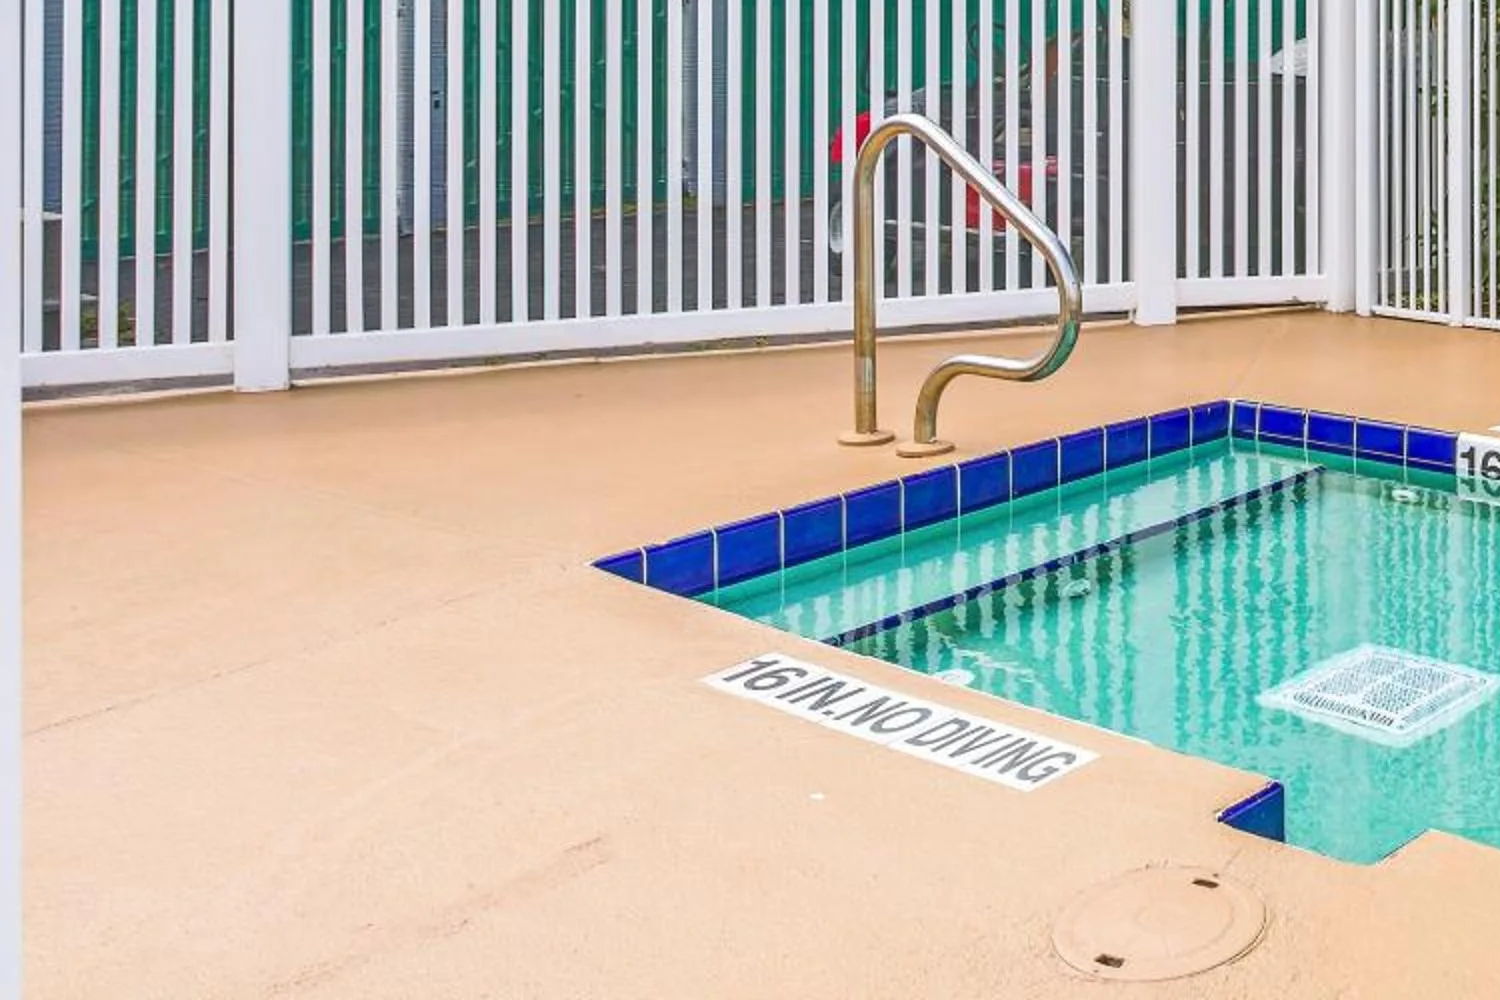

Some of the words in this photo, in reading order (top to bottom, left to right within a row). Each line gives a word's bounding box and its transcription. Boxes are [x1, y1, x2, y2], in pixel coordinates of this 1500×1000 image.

[723, 659, 807, 692] 16
[779, 676, 866, 717] IN.
[835, 696, 933, 736] NO
[904, 717, 1078, 784] DIVING
